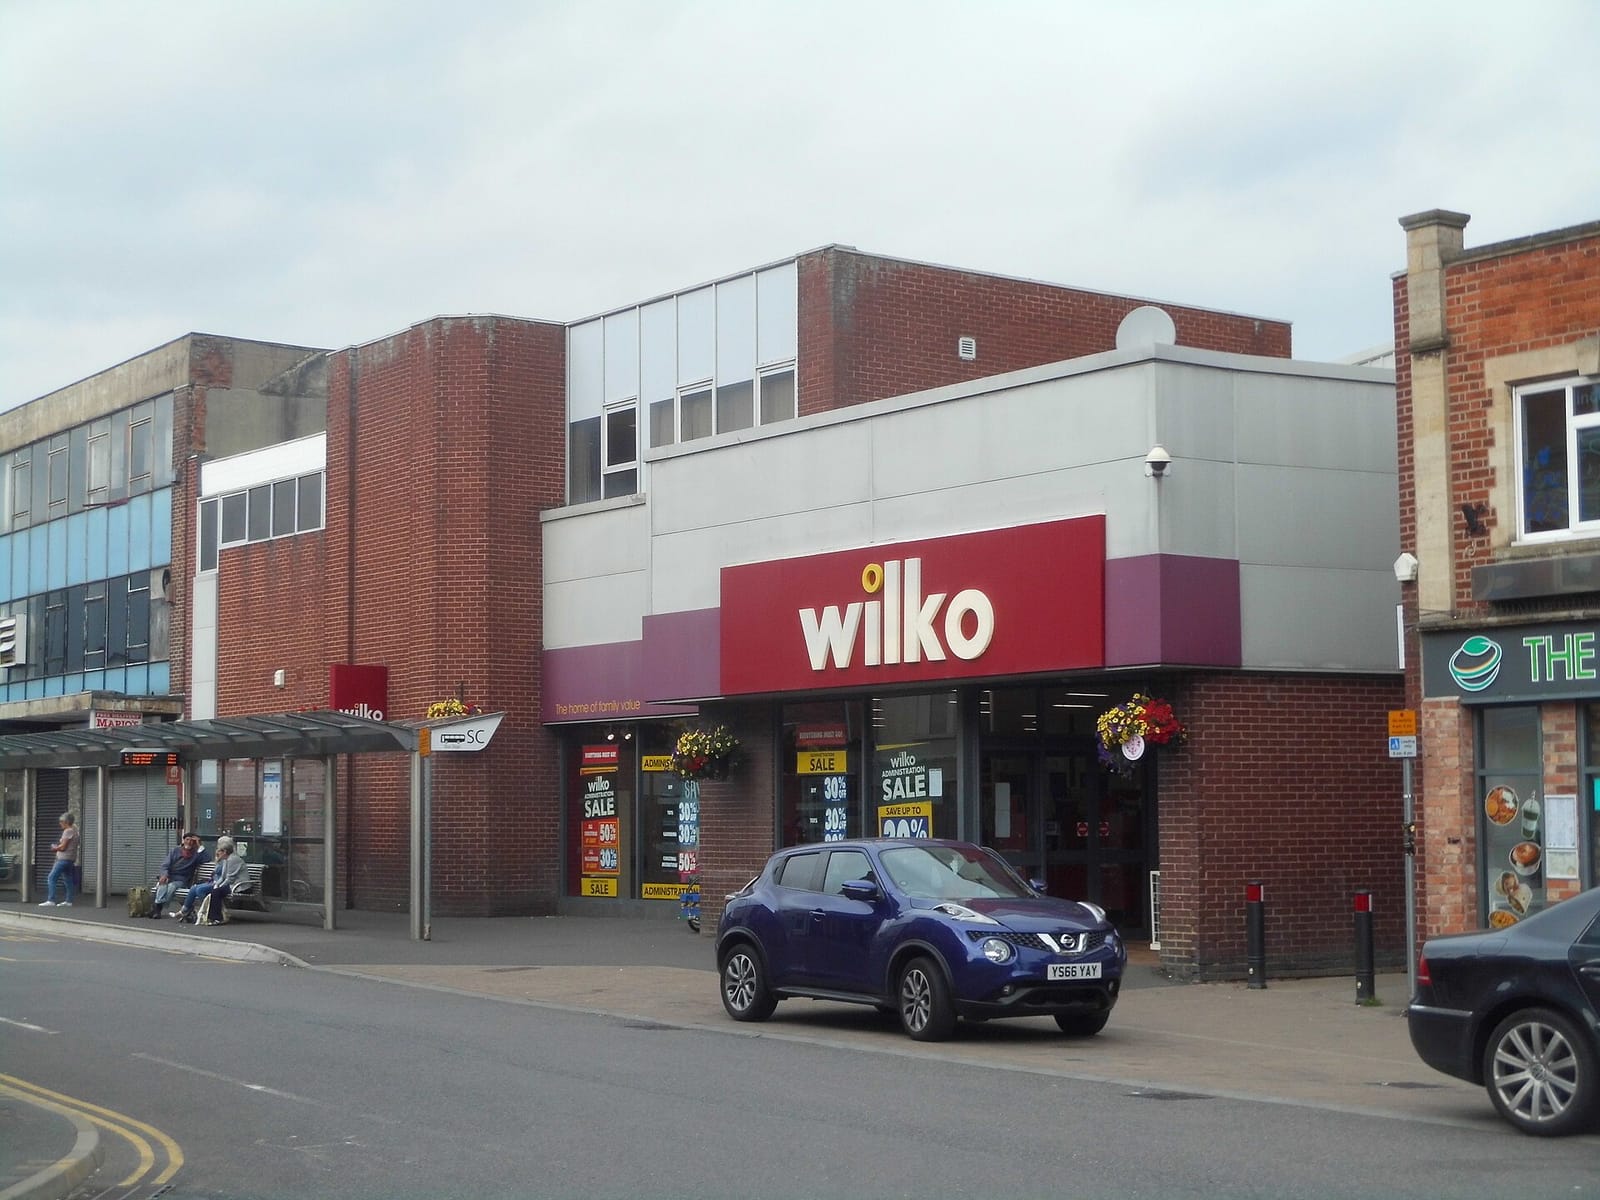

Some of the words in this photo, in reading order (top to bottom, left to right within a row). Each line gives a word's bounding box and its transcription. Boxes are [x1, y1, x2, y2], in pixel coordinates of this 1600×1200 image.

[799, 558, 995, 671] wilko
[1523, 632, 1596, 682] THE
[556, 703, 568, 715] The
[569, 702, 589, 714] home
[590, 701, 598, 713] of
[598, 699, 619, 713] family
[621, 699, 641, 711] value
[467, 729, 485, 744] SC
[809, 758, 835, 771] SALE
[890, 751, 916, 769] wilko
[881, 765, 926, 778] ADMINISTRATION
[587, 775, 610, 793] wilko
[824, 776, 846, 800] 30%
[882, 774, 927, 802] SALE
[584, 797, 615, 818] SALE
[886, 808, 900, 816] SAVE
[901, 807, 911, 815] UP
[912, 806, 922, 815] TO
[825, 808, 846, 831] 30%
[590, 883, 609, 895] SALE
[1052, 966, 1077, 978] YS66
[1080, 965, 1098, 977] YAY
